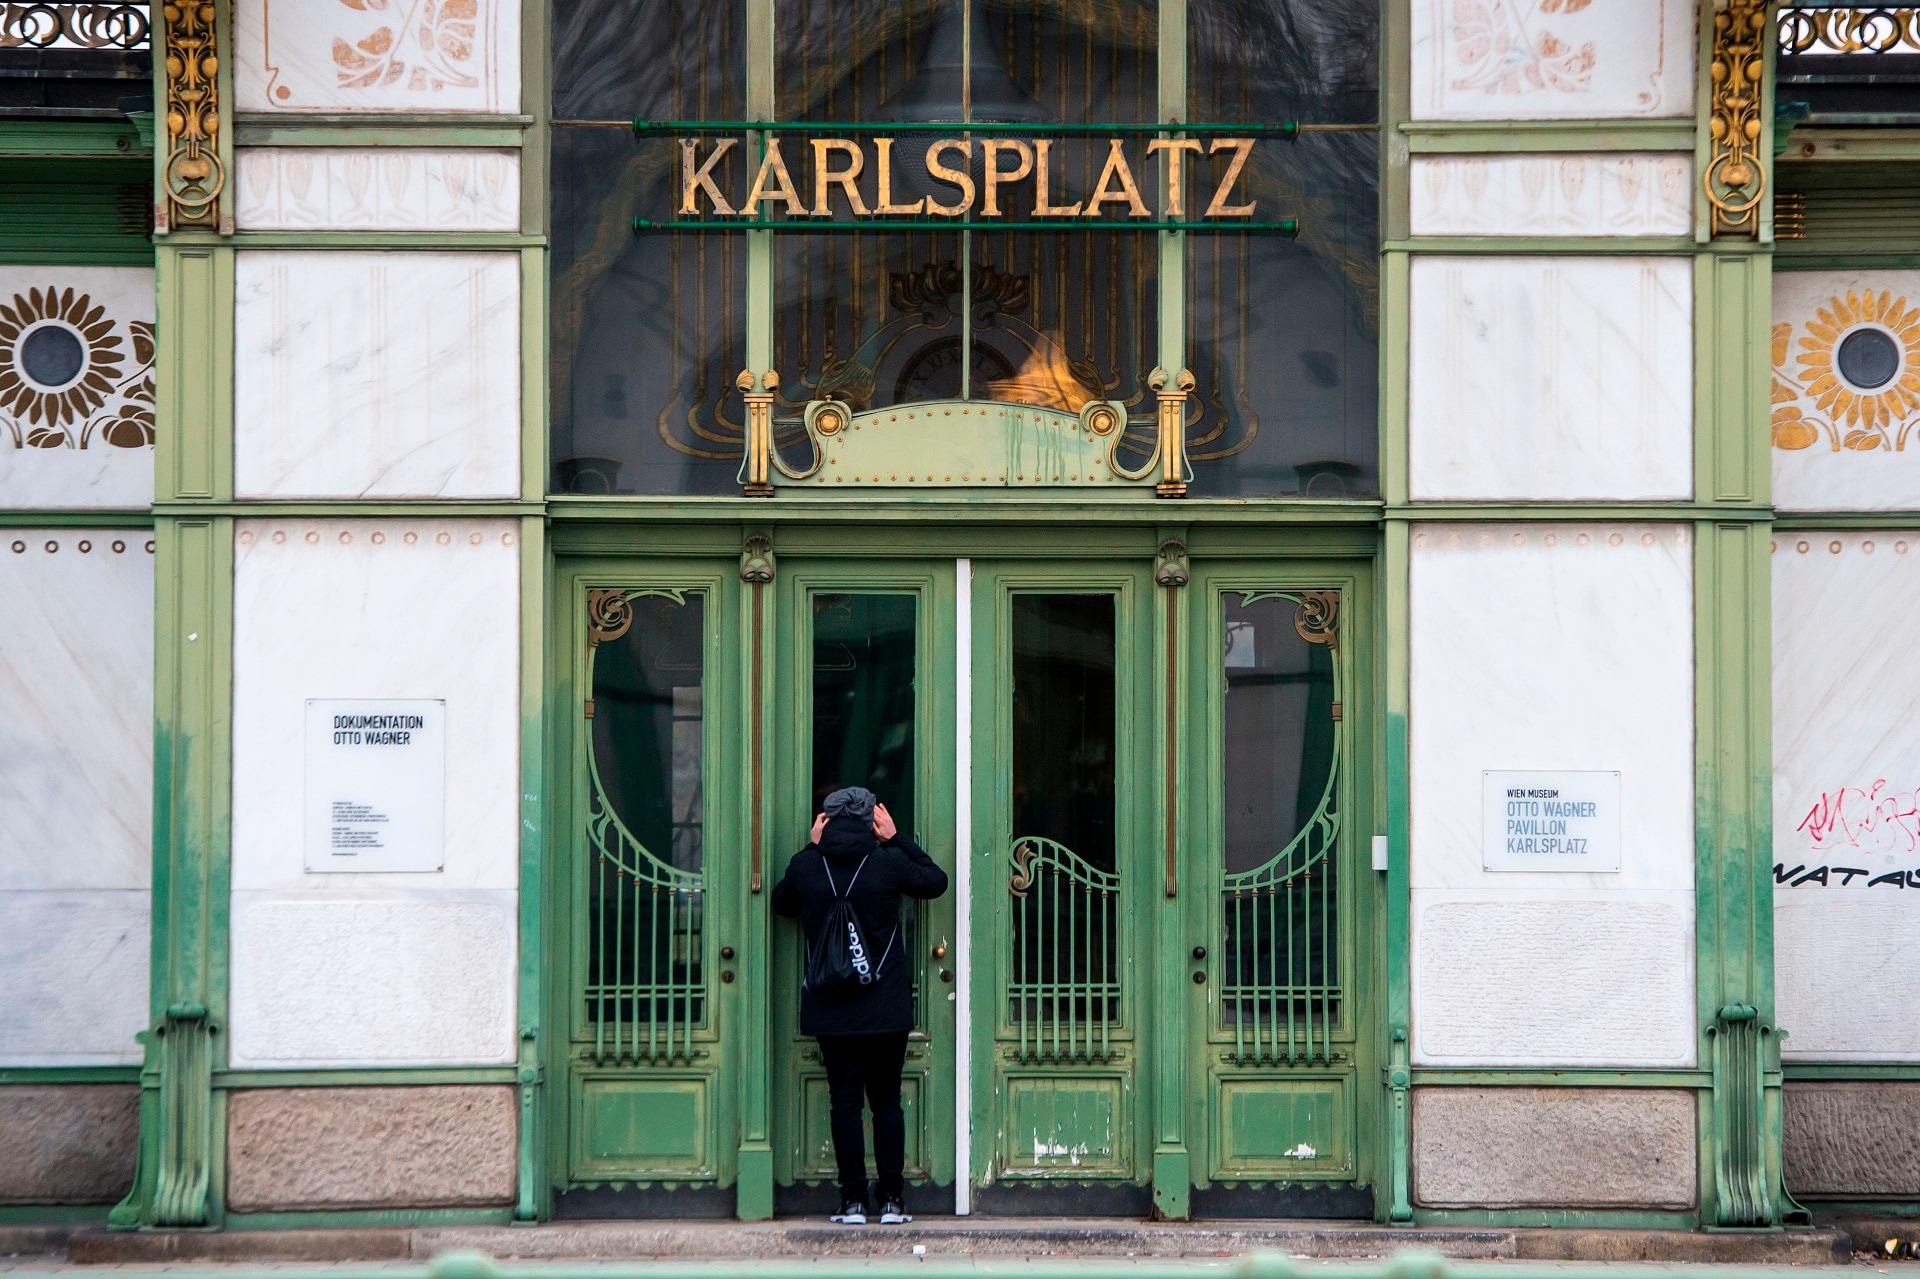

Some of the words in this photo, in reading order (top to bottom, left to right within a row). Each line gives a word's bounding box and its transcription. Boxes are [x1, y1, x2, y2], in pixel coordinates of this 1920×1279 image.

[678, 138, 1257, 217] KARLSPLATZ
[333, 715, 424, 729] DOKUMENTATION
[333, 731, 361, 745] OTTO
[364, 731, 411, 745] WAGNER
[1507, 789, 1526, 798] WIEN
[1528, 789, 1559, 798] MUSEUM
[1507, 801, 1539, 817] OTTO
[1543, 801, 1597, 818] WAGNER
[1507, 819, 1567, 836] PAVILLON
[1507, 837, 1588, 854] KARLSPLATZ
[848, 921, 872, 985] adidas
